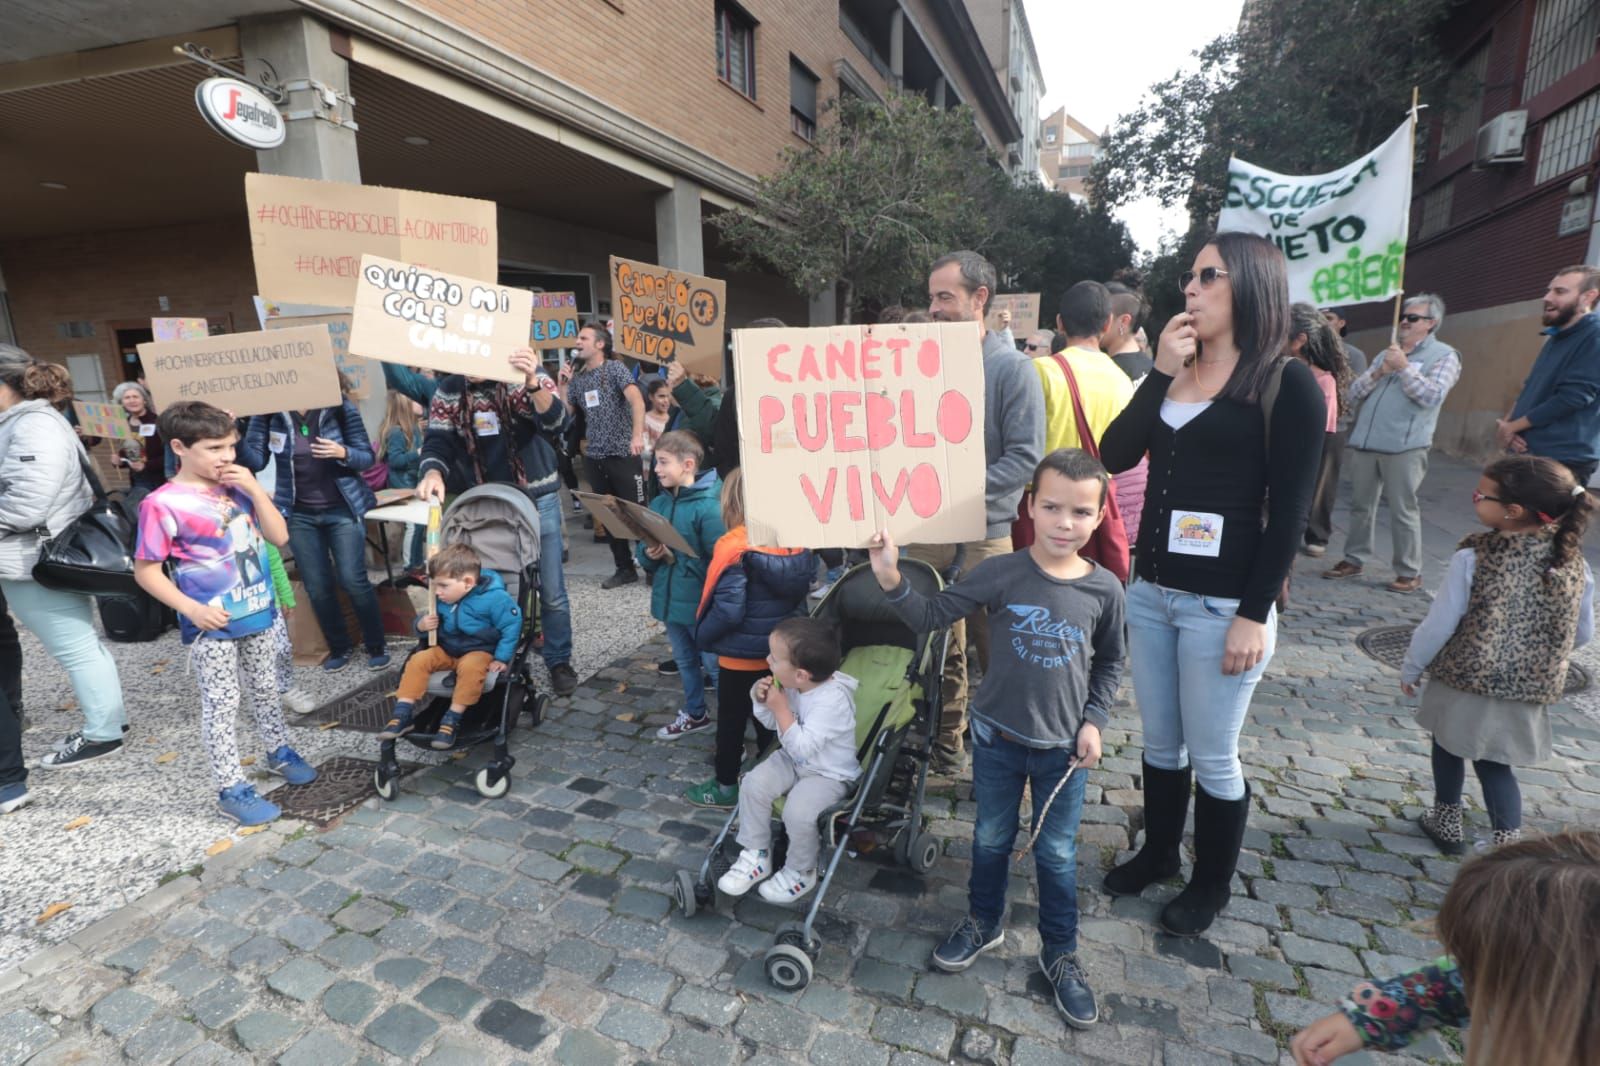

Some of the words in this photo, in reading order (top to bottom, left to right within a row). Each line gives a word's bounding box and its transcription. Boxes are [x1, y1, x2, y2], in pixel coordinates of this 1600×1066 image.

[223, 88, 277, 129] Segafredo
[1270, 211, 1305, 230] DE
[616, 262, 690, 307] Caneto
[383, 291, 447, 329] COLE
[532, 317, 578, 342] EDA
[619, 295, 690, 334] Pueblo
[622, 324, 676, 360] Vivo
[766, 338, 941, 384] CANETO
[758, 389, 973, 454] PUEBLO
[798, 462, 943, 524] VIVO
[1012, 636, 1080, 669] CALIFORNA
